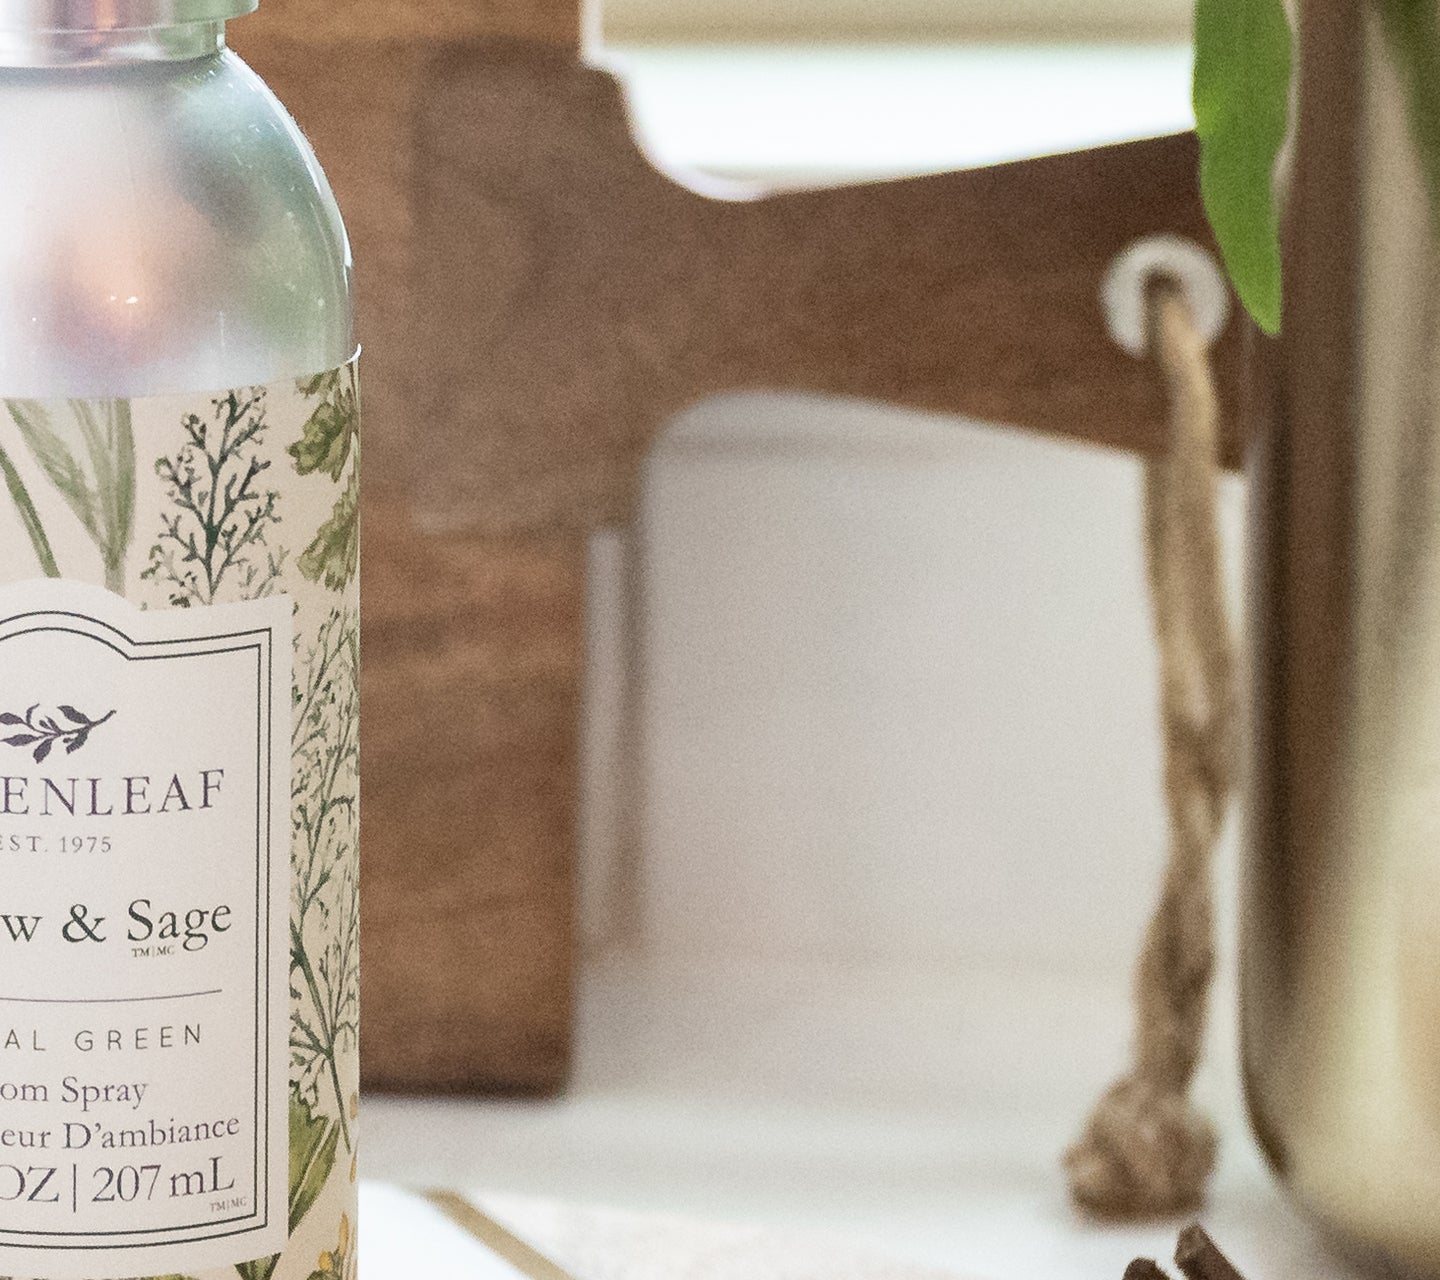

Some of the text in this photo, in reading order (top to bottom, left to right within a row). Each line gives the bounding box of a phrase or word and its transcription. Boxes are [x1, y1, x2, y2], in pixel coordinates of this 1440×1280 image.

[61, 836, 111, 853] 1975
[62, 904, 106, 943] &
[127, 899, 231, 952] Sage
[74, 1024, 200, 1052] GREEN
[62, 1076, 148, 1112] Spray
[64, 1118, 239, 1149] D’ambiance
[92, 1164, 161, 1202] 207
[170, 1157, 234, 1197] mL
